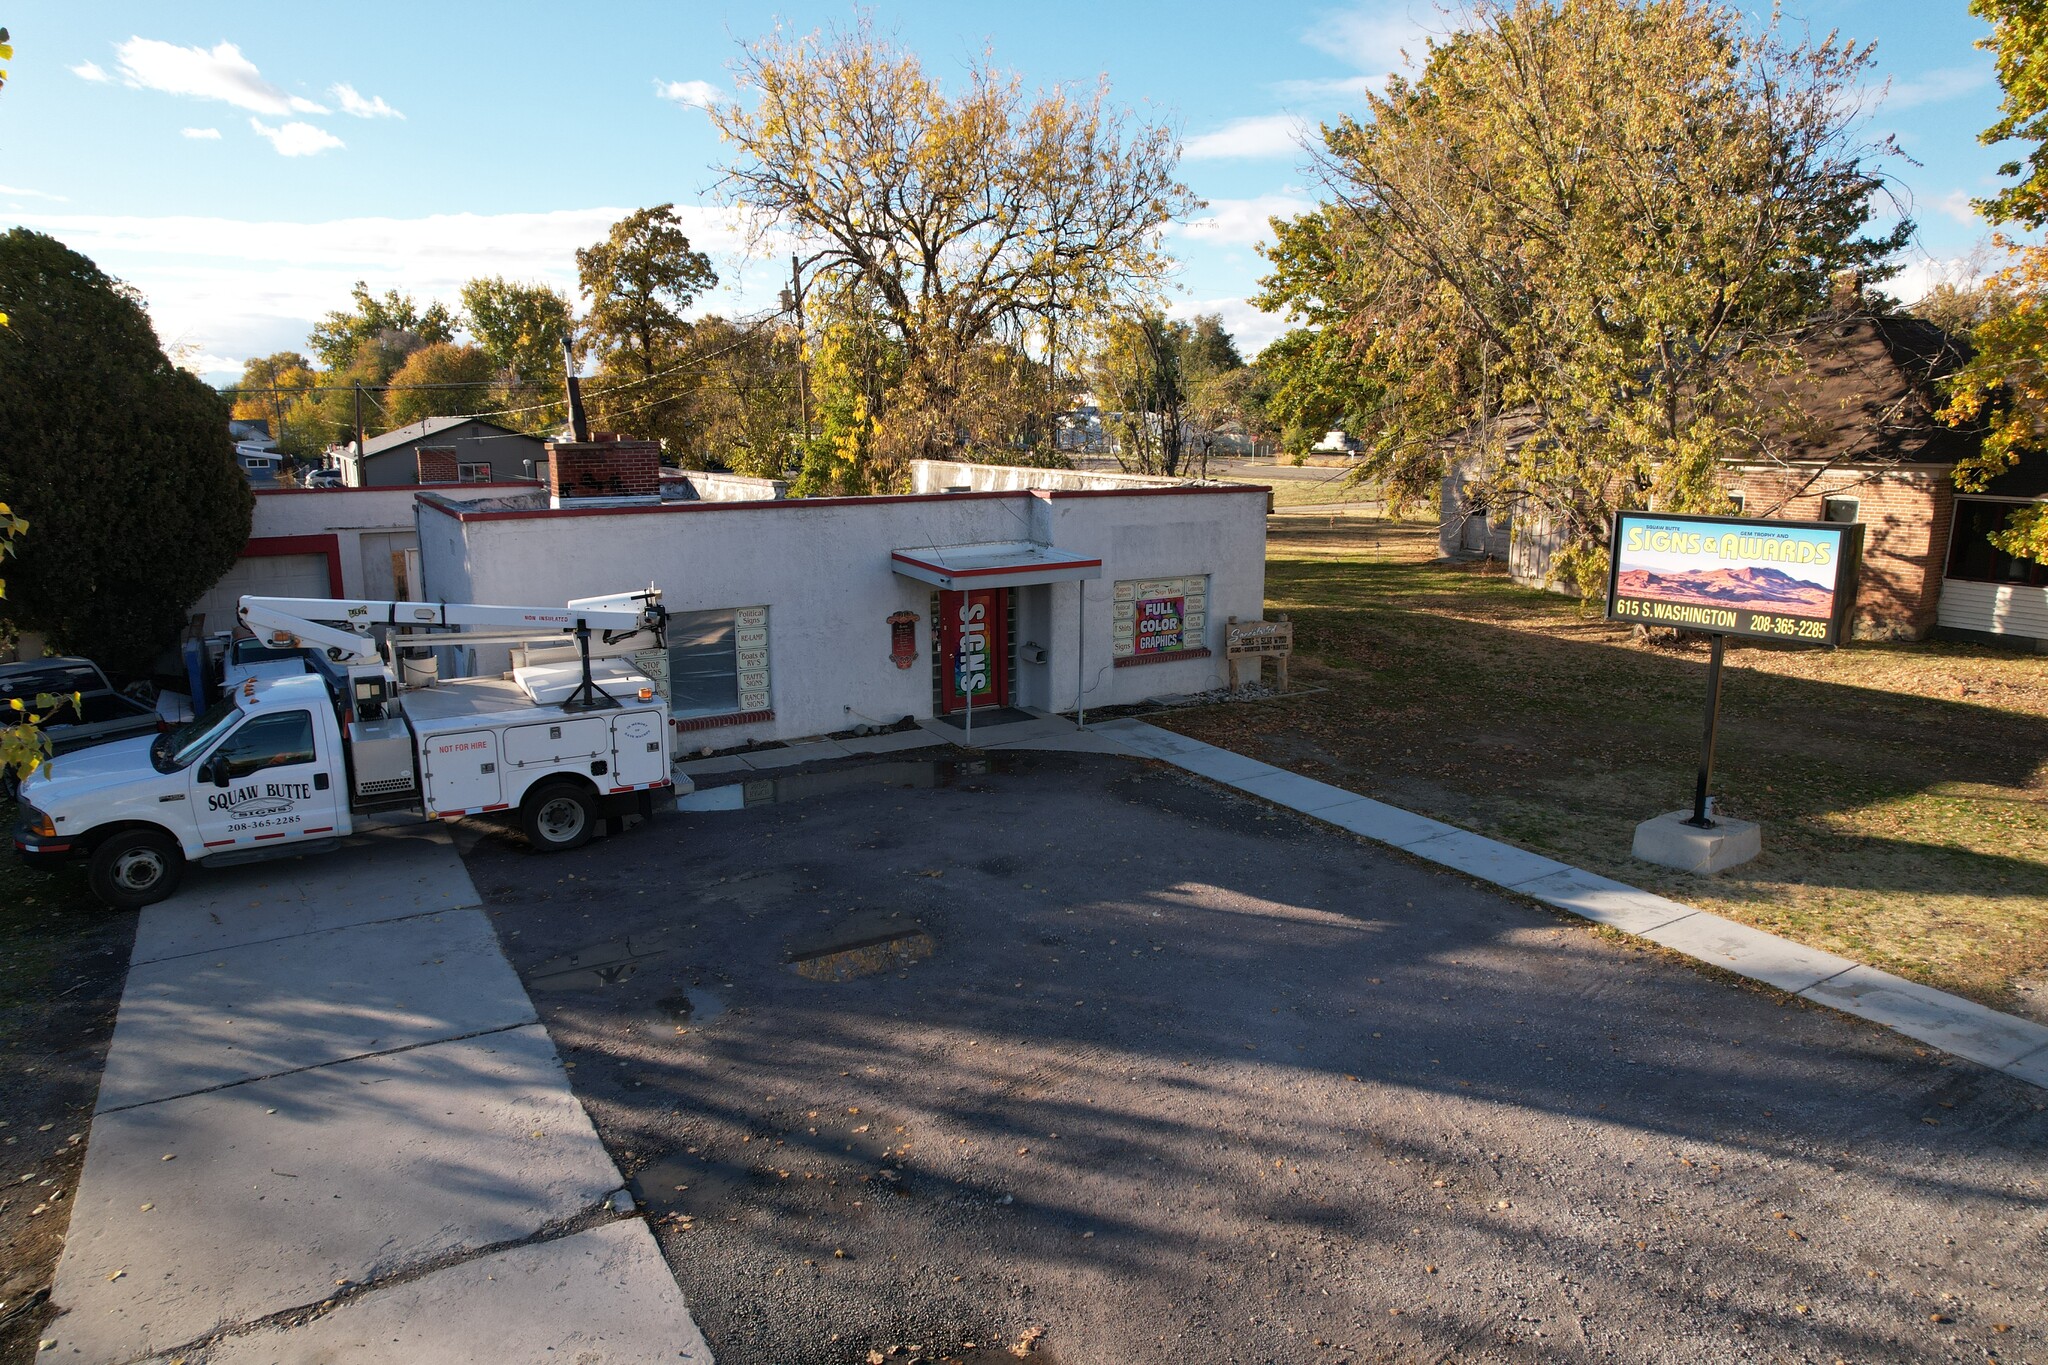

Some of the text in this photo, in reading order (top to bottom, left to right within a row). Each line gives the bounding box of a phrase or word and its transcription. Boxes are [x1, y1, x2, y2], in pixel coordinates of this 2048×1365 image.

[1627, 527, 1831, 565] SIGNS & AWARDS
[1167, 587, 1180, 595] Work
[1145, 602, 1173, 616] FULL
[1616, 599, 1639, 616] 615
[739, 609, 764, 618] Political
[743, 617, 760, 625] Signs
[1140, 618, 1178, 633] COLOR
[1750, 614, 1827, 639] 208-365-2285
[1140, 634, 1177, 649] GRAPHICS
[959, 603, 986, 692] SIGNS
[1115, 643, 1130, 652] Signs
[741, 652, 758, 660] Boats
[643, 661, 660, 670] STOP
[743, 672, 765, 680] TRAFFIC
[746, 679, 763, 687] SIGNS
[744, 693, 765, 701] RANCH
[746, 700, 765, 708] SIGNS
[438, 741, 487, 754] NOT FOR HIRE
[208, 784, 311, 811] SQUAW BUTTE
[239, 807, 287, 817] SIGNS
[228, 815, 301, 832] 208-365-2285
